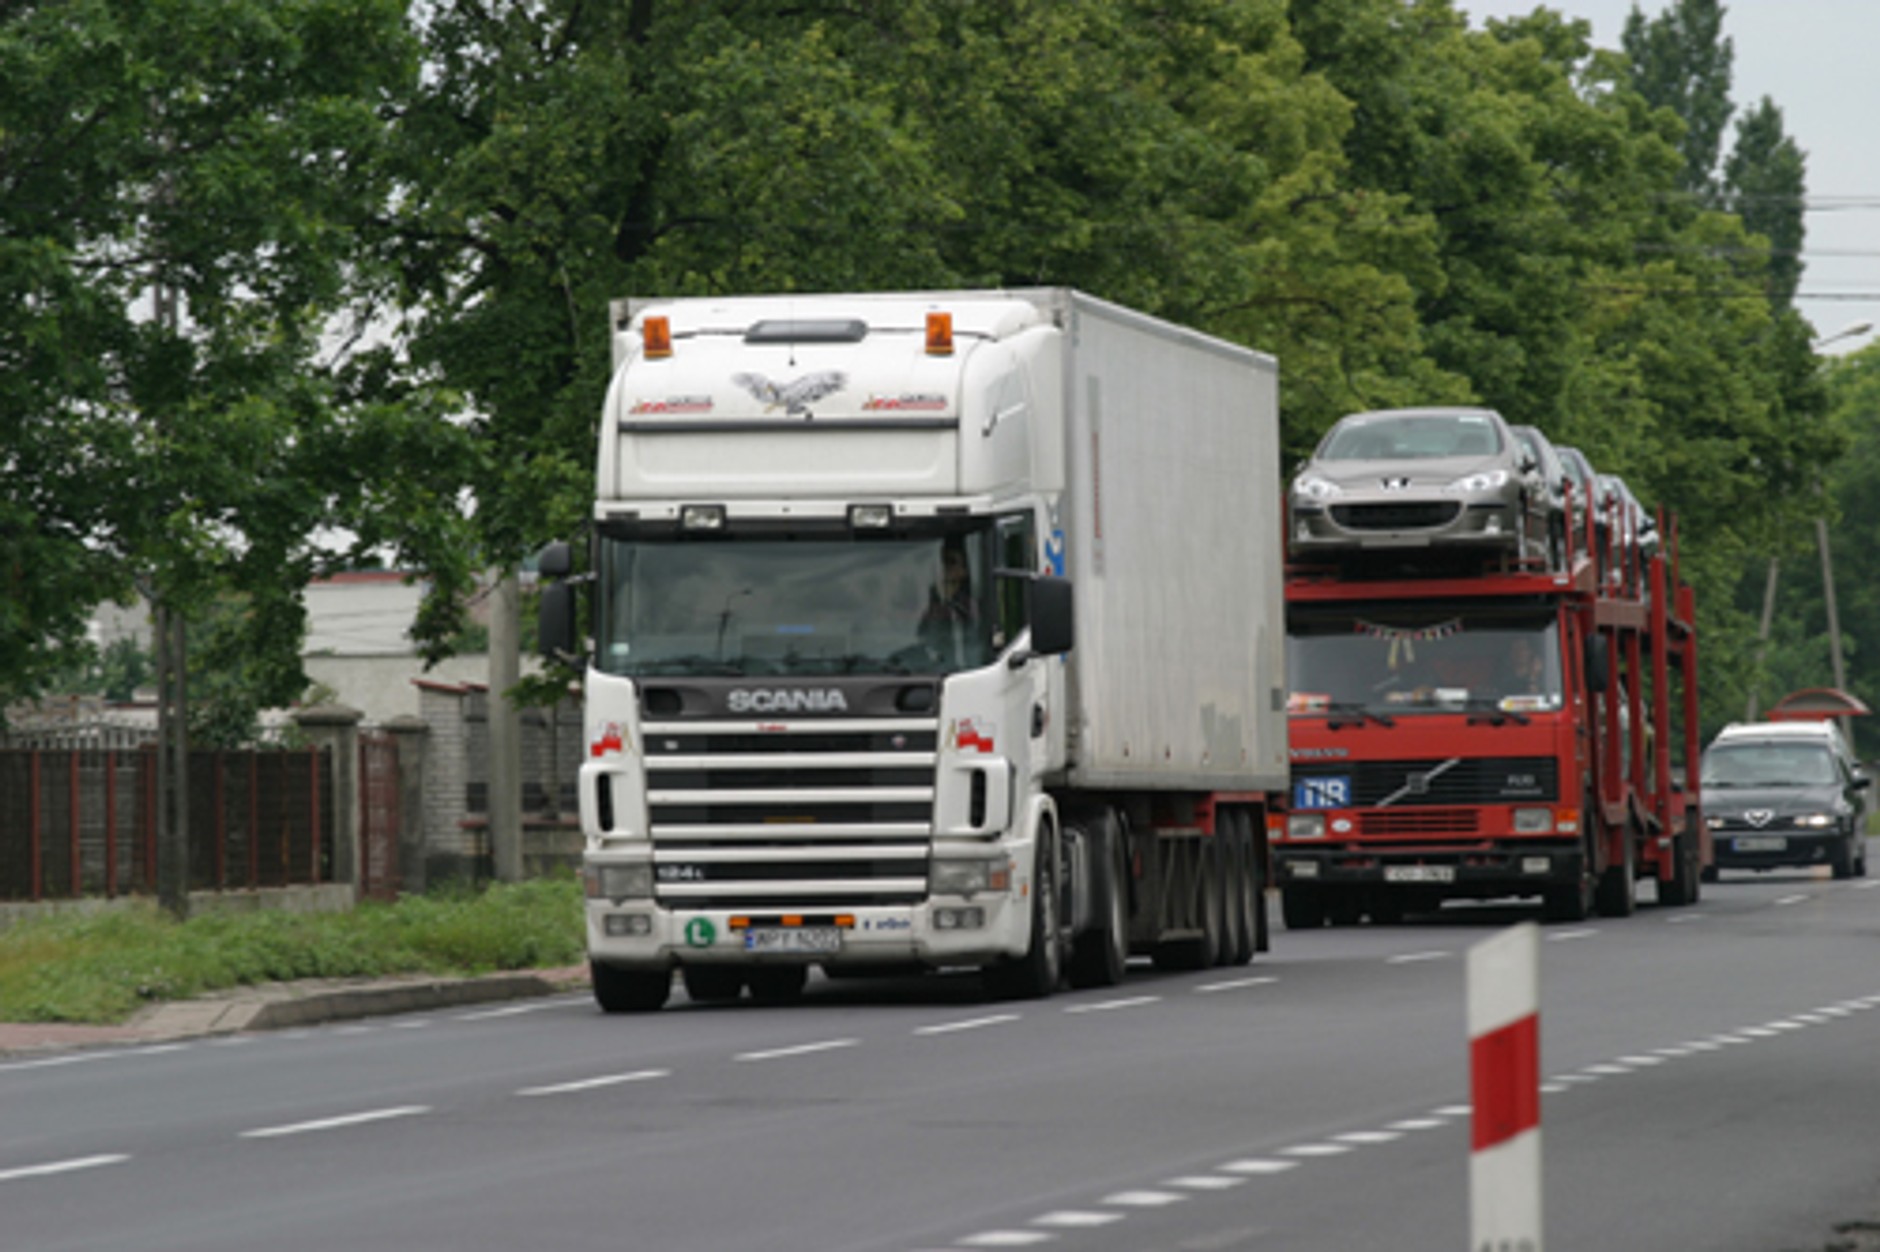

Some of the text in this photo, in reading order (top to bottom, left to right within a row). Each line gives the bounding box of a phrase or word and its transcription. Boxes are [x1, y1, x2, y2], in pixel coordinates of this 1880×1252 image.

[728, 689, 847, 711] SCANIA
[1304, 779, 1345, 807] TIR
[692, 922, 709, 944] L
